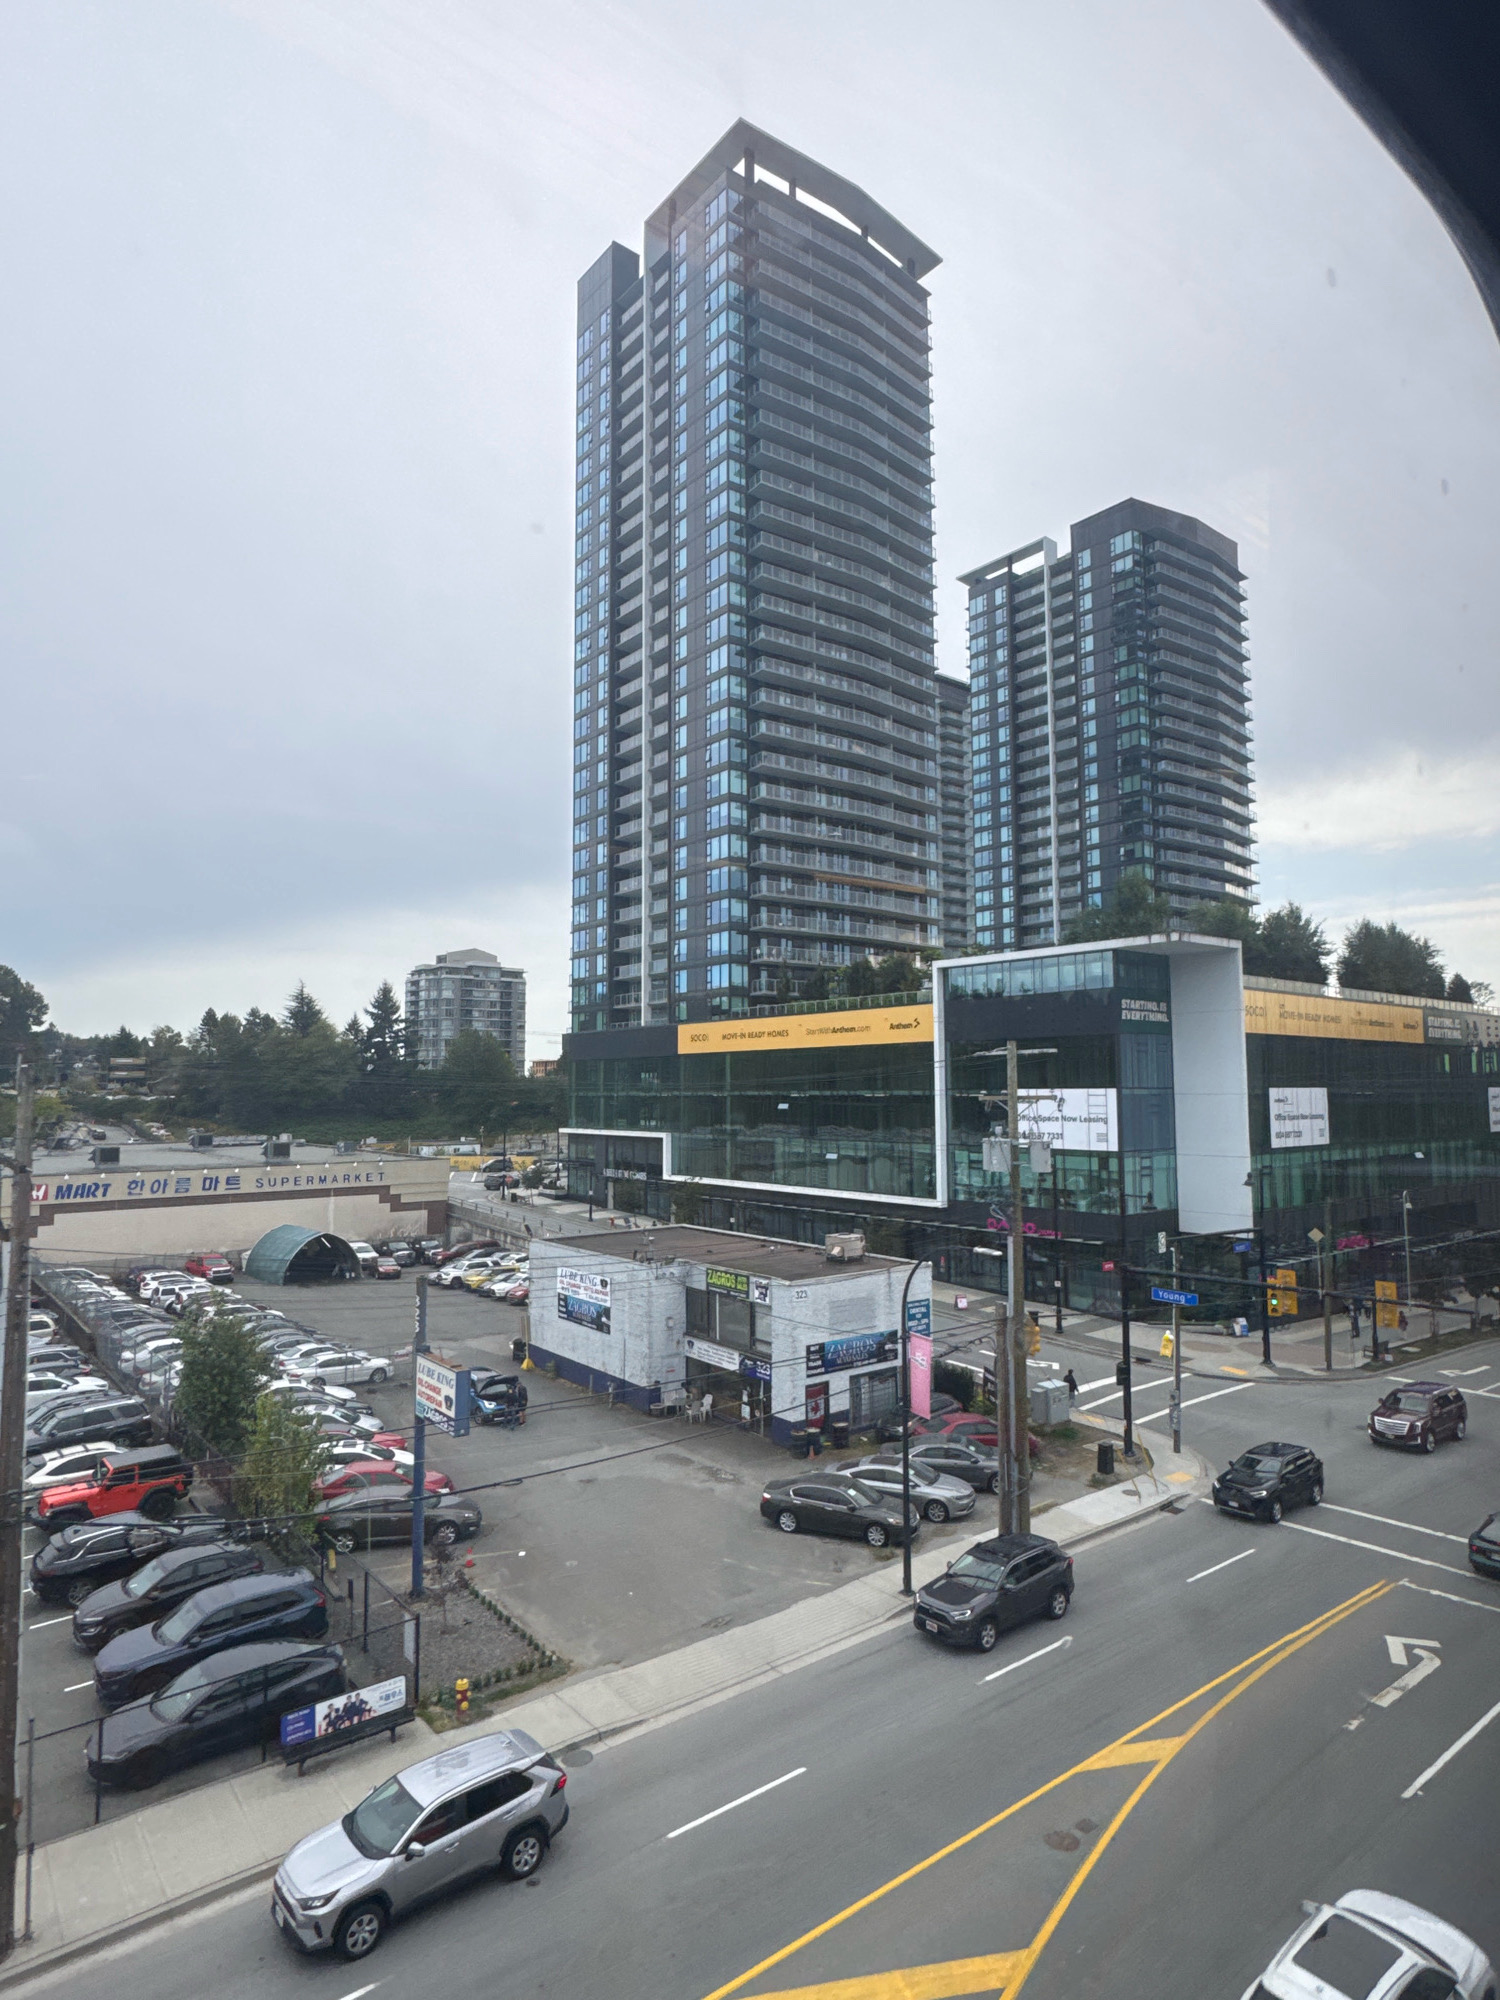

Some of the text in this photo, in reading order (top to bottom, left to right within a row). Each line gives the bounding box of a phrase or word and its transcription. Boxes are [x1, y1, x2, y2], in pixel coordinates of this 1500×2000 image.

[767, 1029, 789, 1038] HOMES
[1037, 1114, 1059, 1123] Space
[1079, 1115, 1108, 1125] Leasing
[127, 1176, 241, 1196] 한아름 마트
[256, 1172, 385, 1188] SUPERMARKET
[55, 1182, 112, 1200] MART
[707, 1269, 736, 1289] ZAGROS
[795, 1290, 808, 1300] 323
[1158, 1290, 1185, 1304] Young
[827, 1338, 877, 1360] ZAGROS
[417, 1362, 455, 1389] LUBE KING
